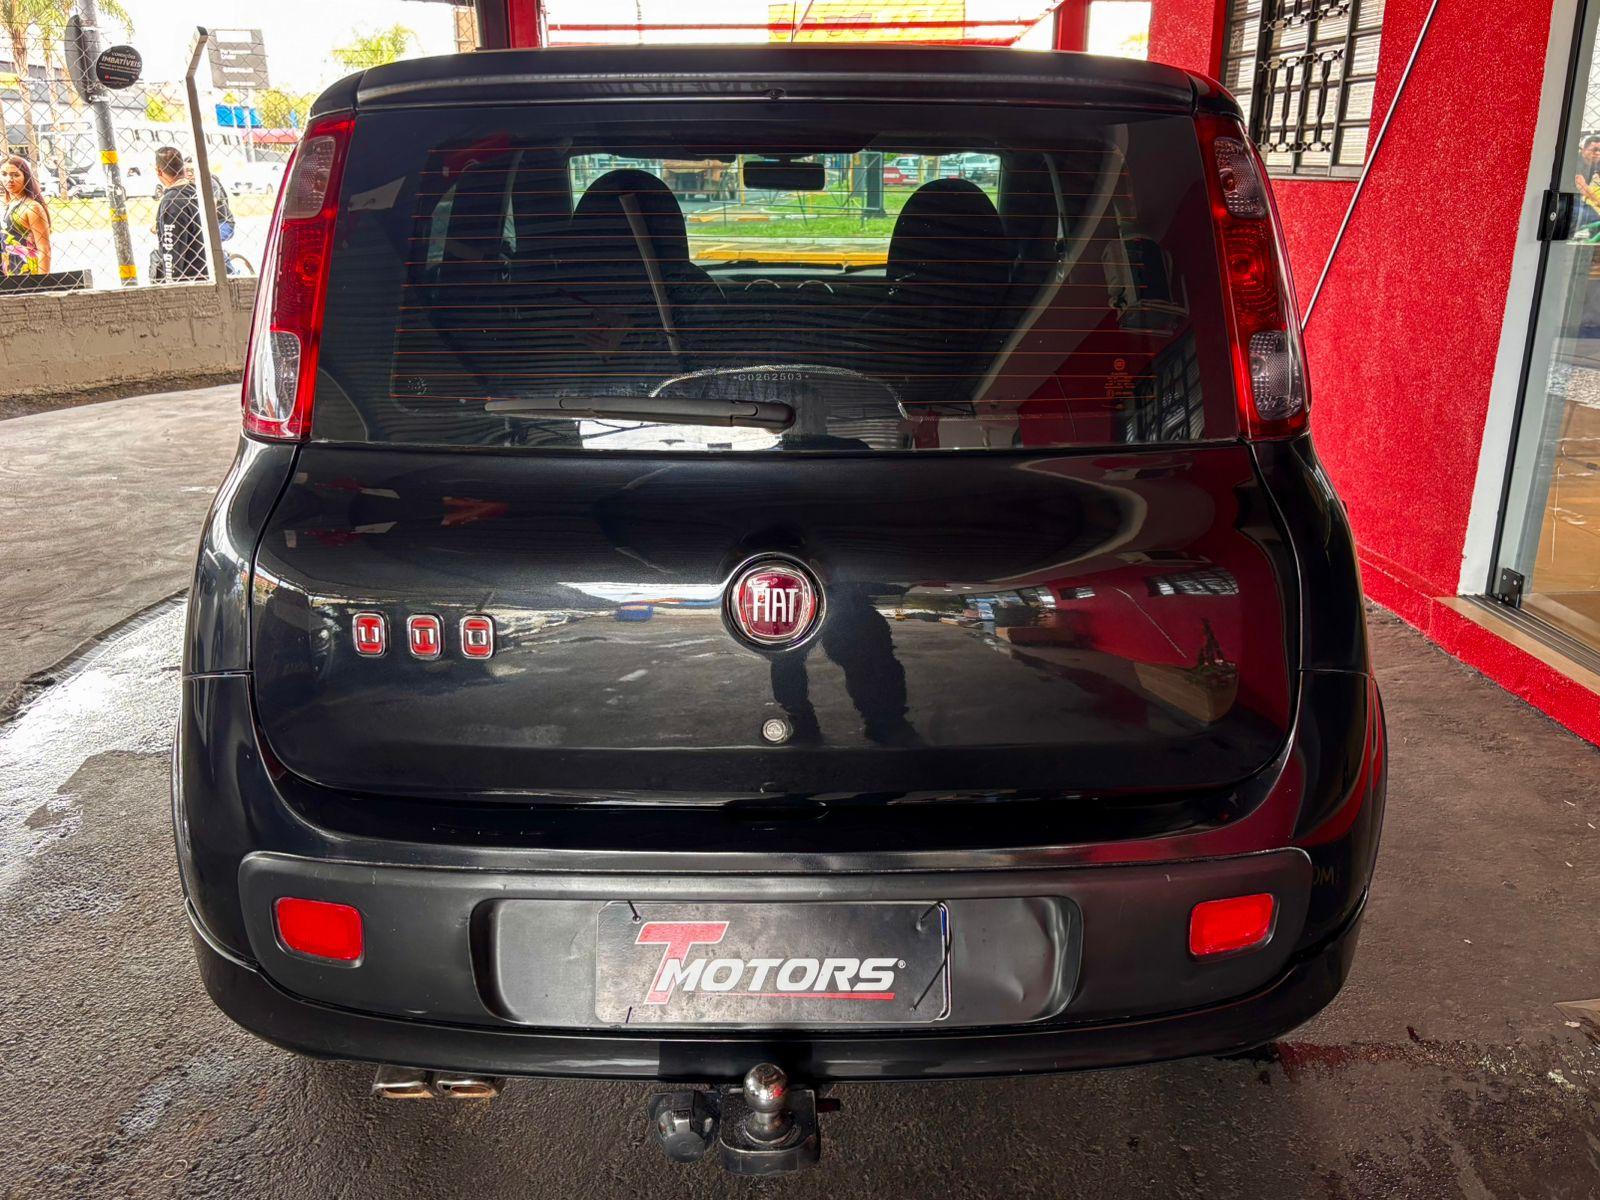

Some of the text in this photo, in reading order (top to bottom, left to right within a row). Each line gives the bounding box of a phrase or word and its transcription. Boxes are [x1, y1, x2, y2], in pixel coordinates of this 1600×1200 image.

[101, 55, 142, 68] IMBATÍVEIS
[752, 587, 799, 623] FIAT
[652, 957, 900, 992] MOTORS
